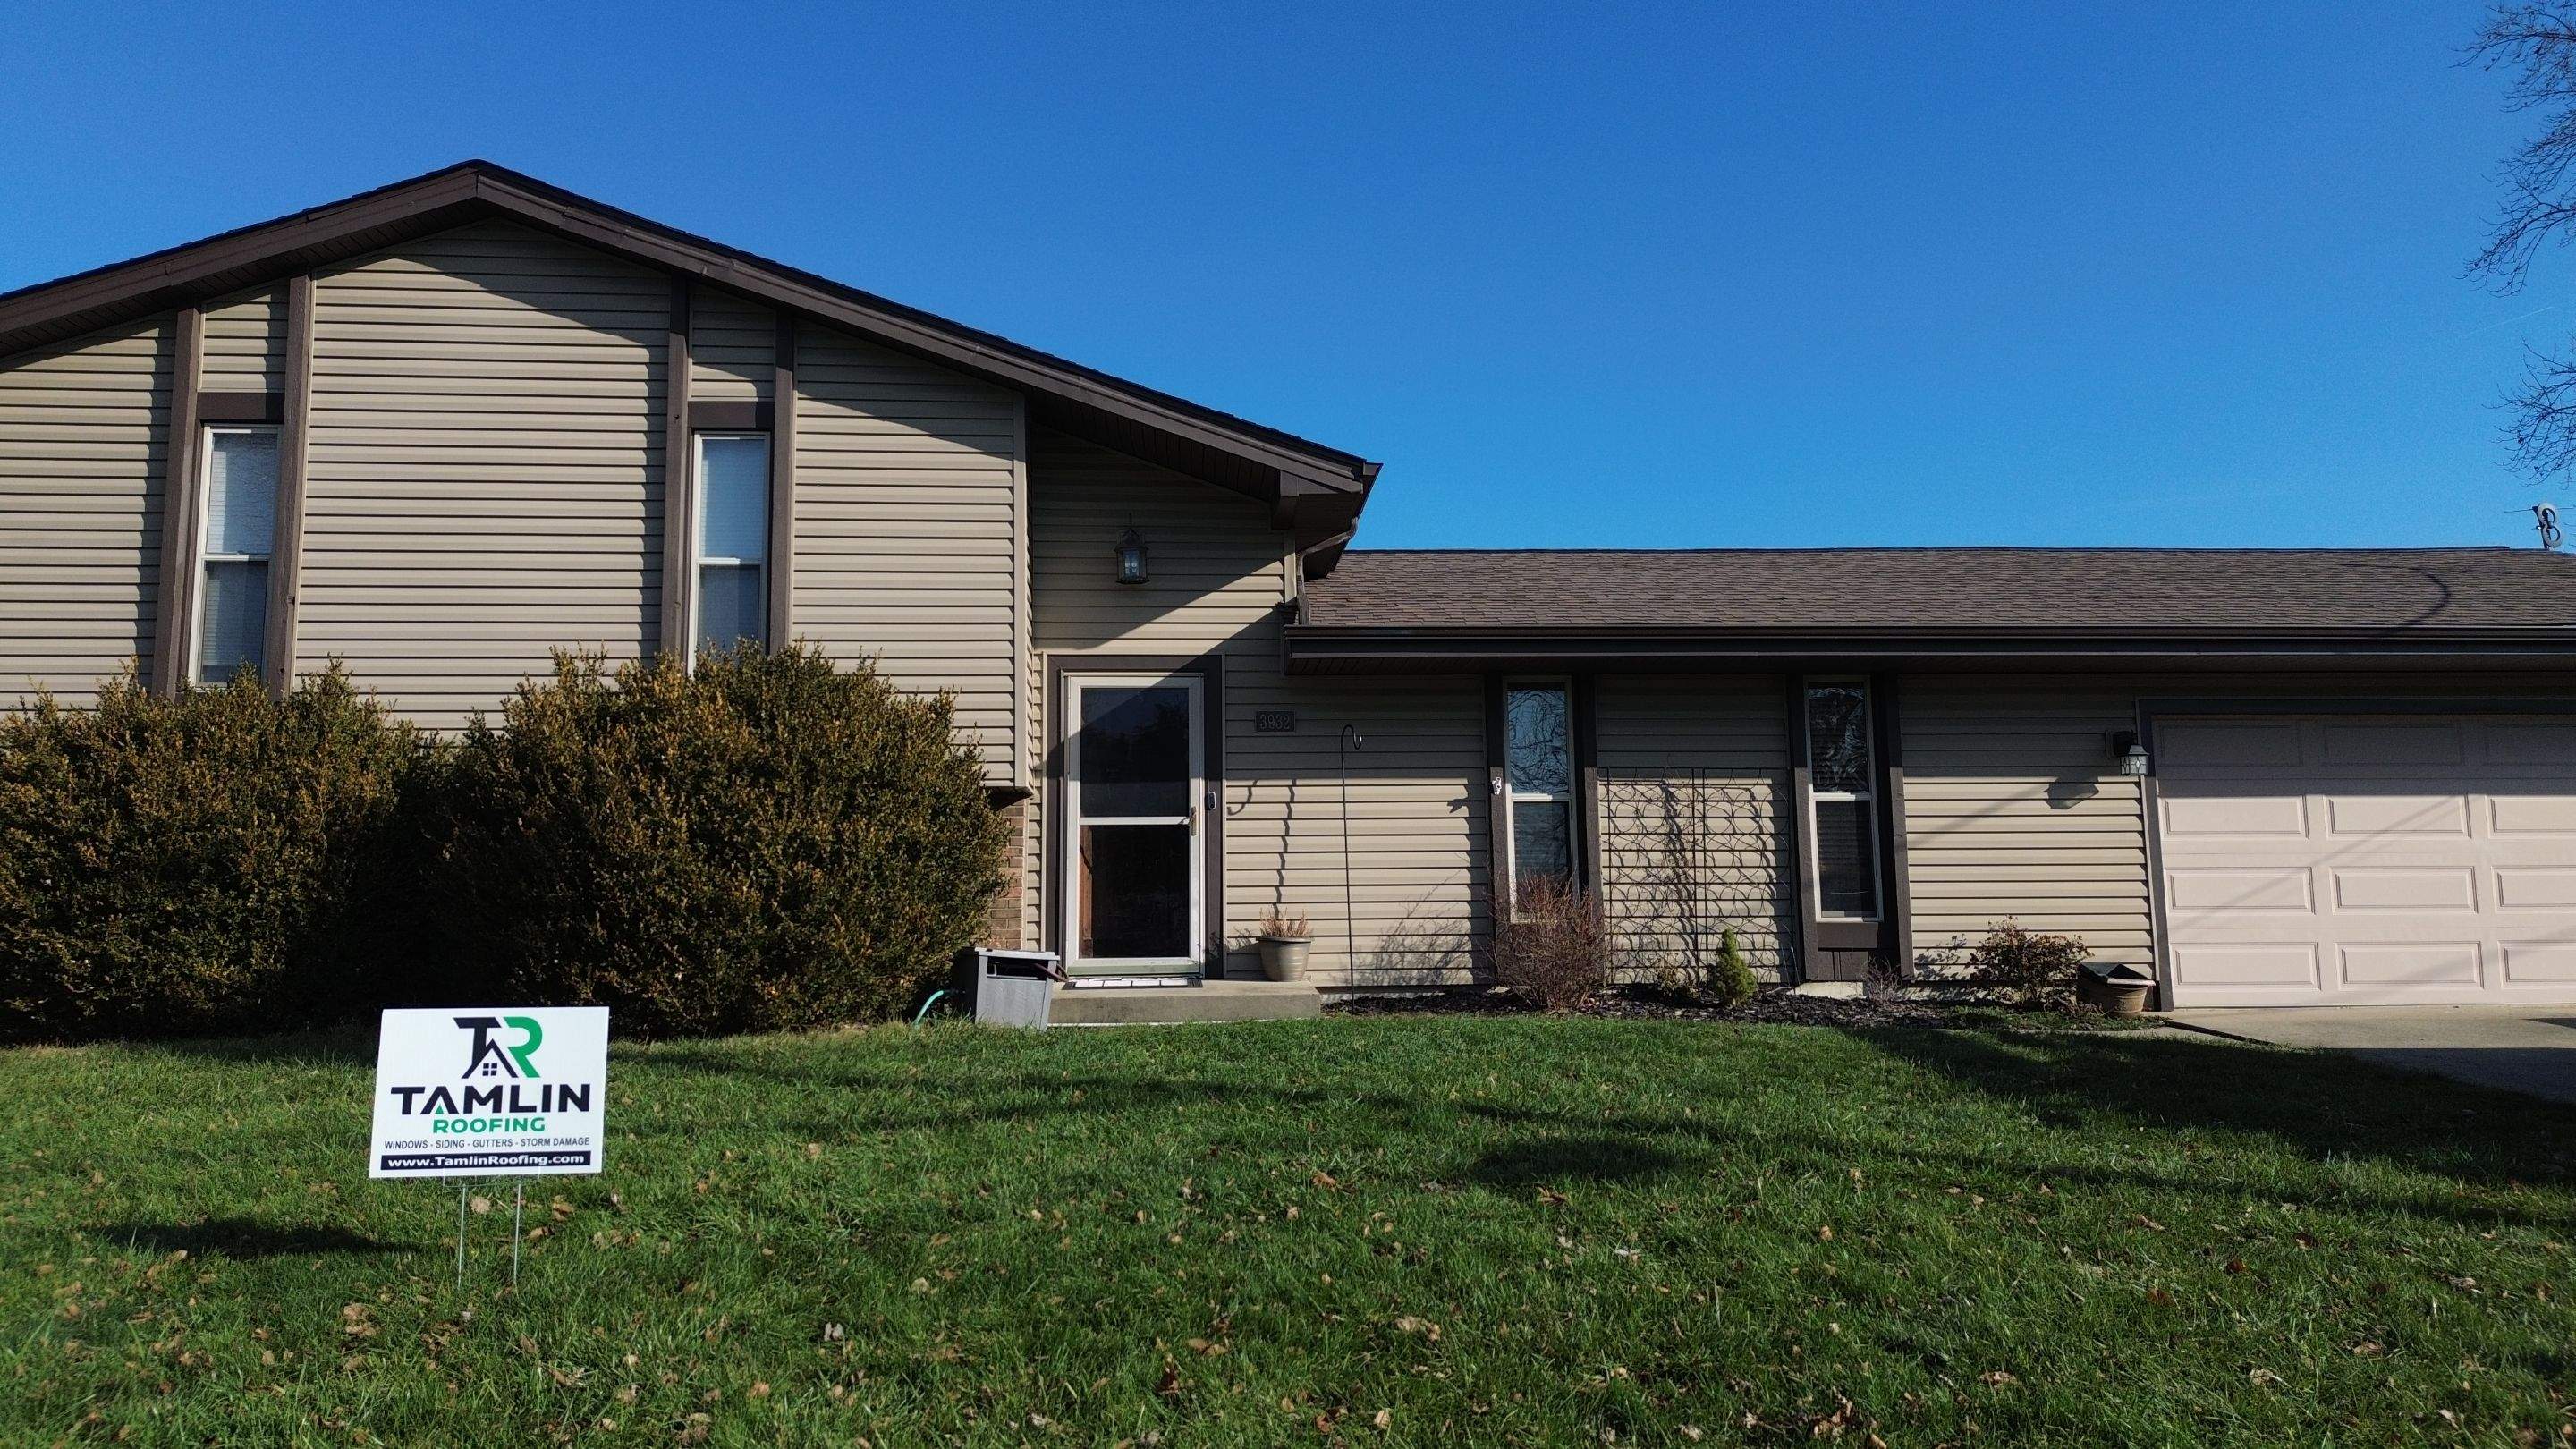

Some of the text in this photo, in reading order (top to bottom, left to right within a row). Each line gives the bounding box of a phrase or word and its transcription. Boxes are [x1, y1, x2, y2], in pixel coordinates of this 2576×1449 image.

[1259, 714, 1290, 729] 3932
[390, 1084, 590, 1115] TAMLIN
[432, 1116, 546, 1134] ROOFING
[384, 1136, 590, 1149] WINDOWS SIDING GUTTERS STORM DAMAGE
[387, 1154, 584, 1167] www.TamlinRoofing.com
